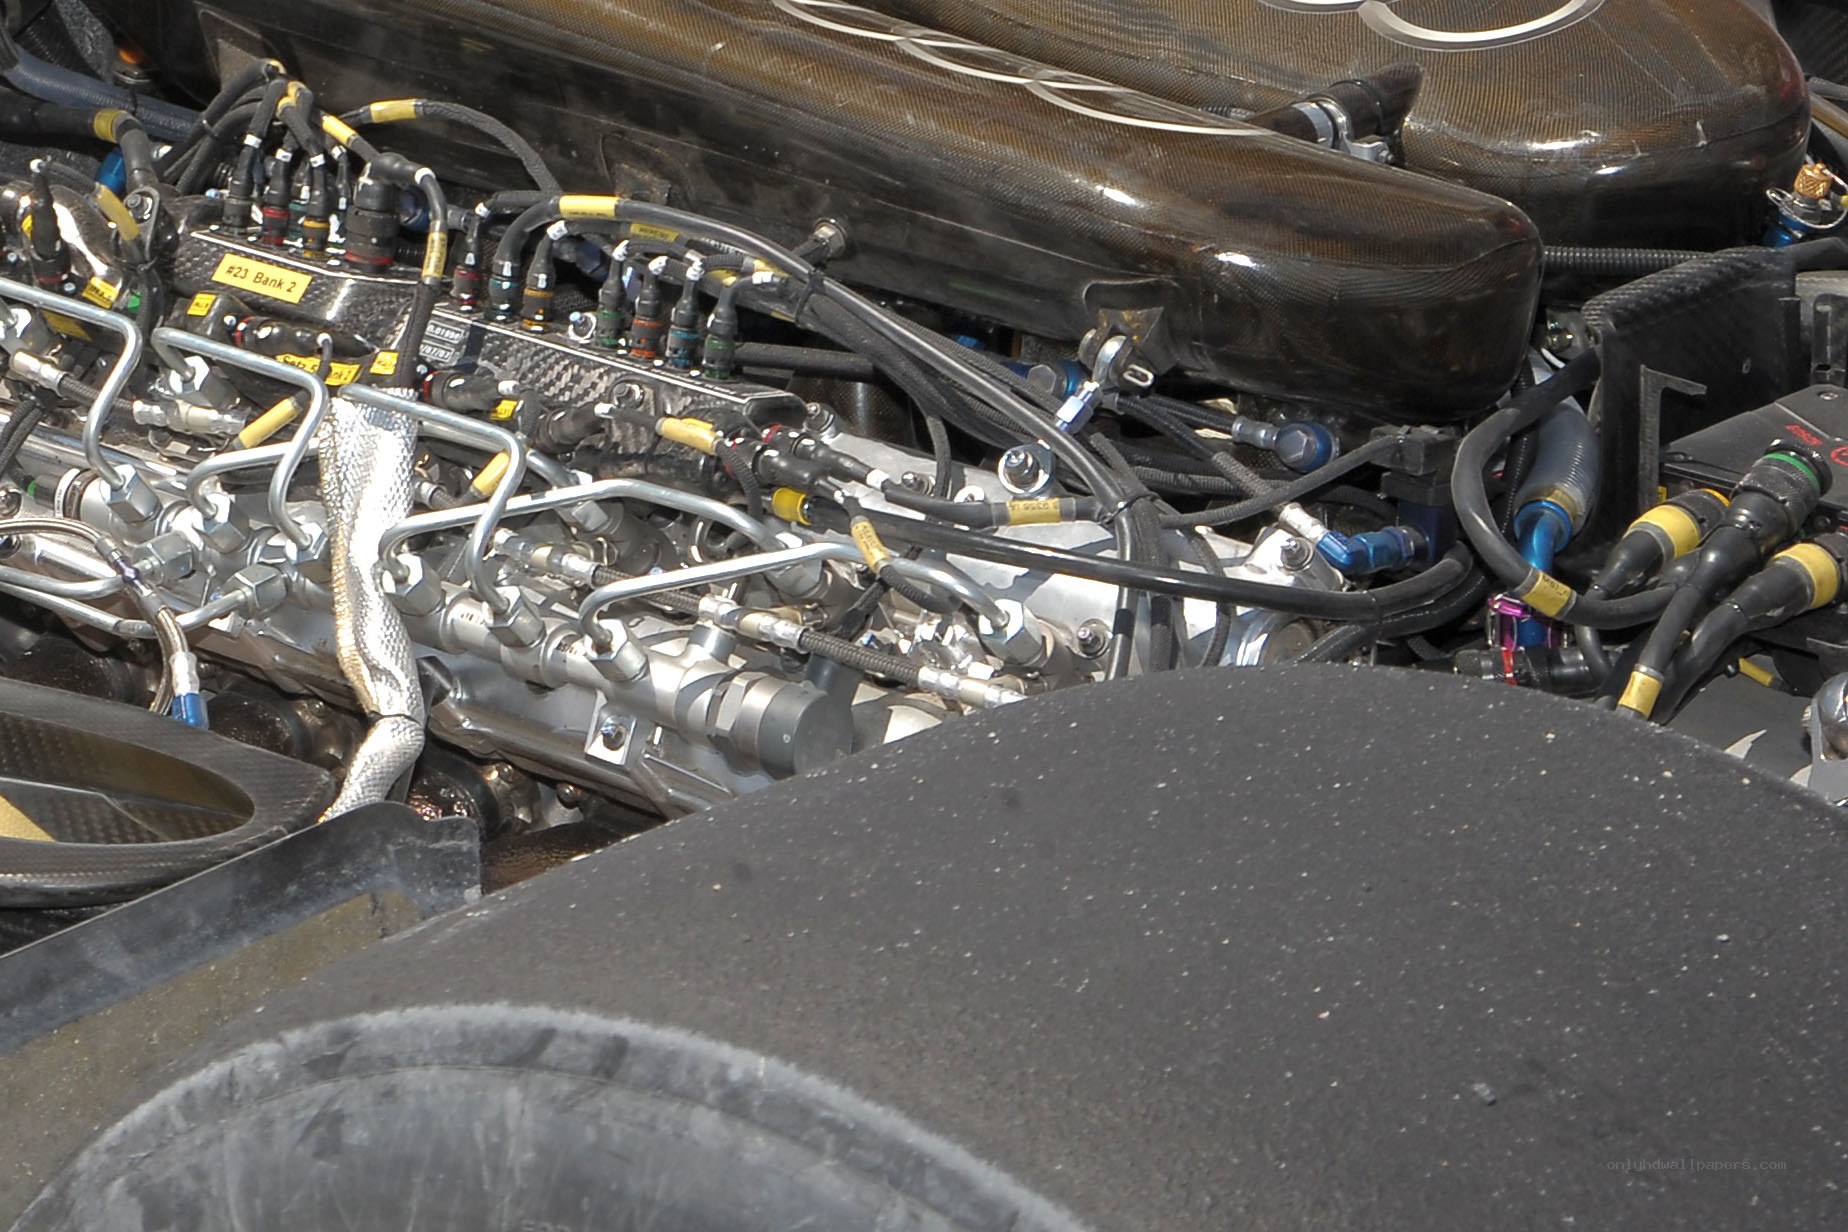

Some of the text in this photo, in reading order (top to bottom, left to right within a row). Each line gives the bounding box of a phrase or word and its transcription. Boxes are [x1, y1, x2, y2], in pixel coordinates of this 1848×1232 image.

[225, 266, 297, 294] #23 Bank 2
